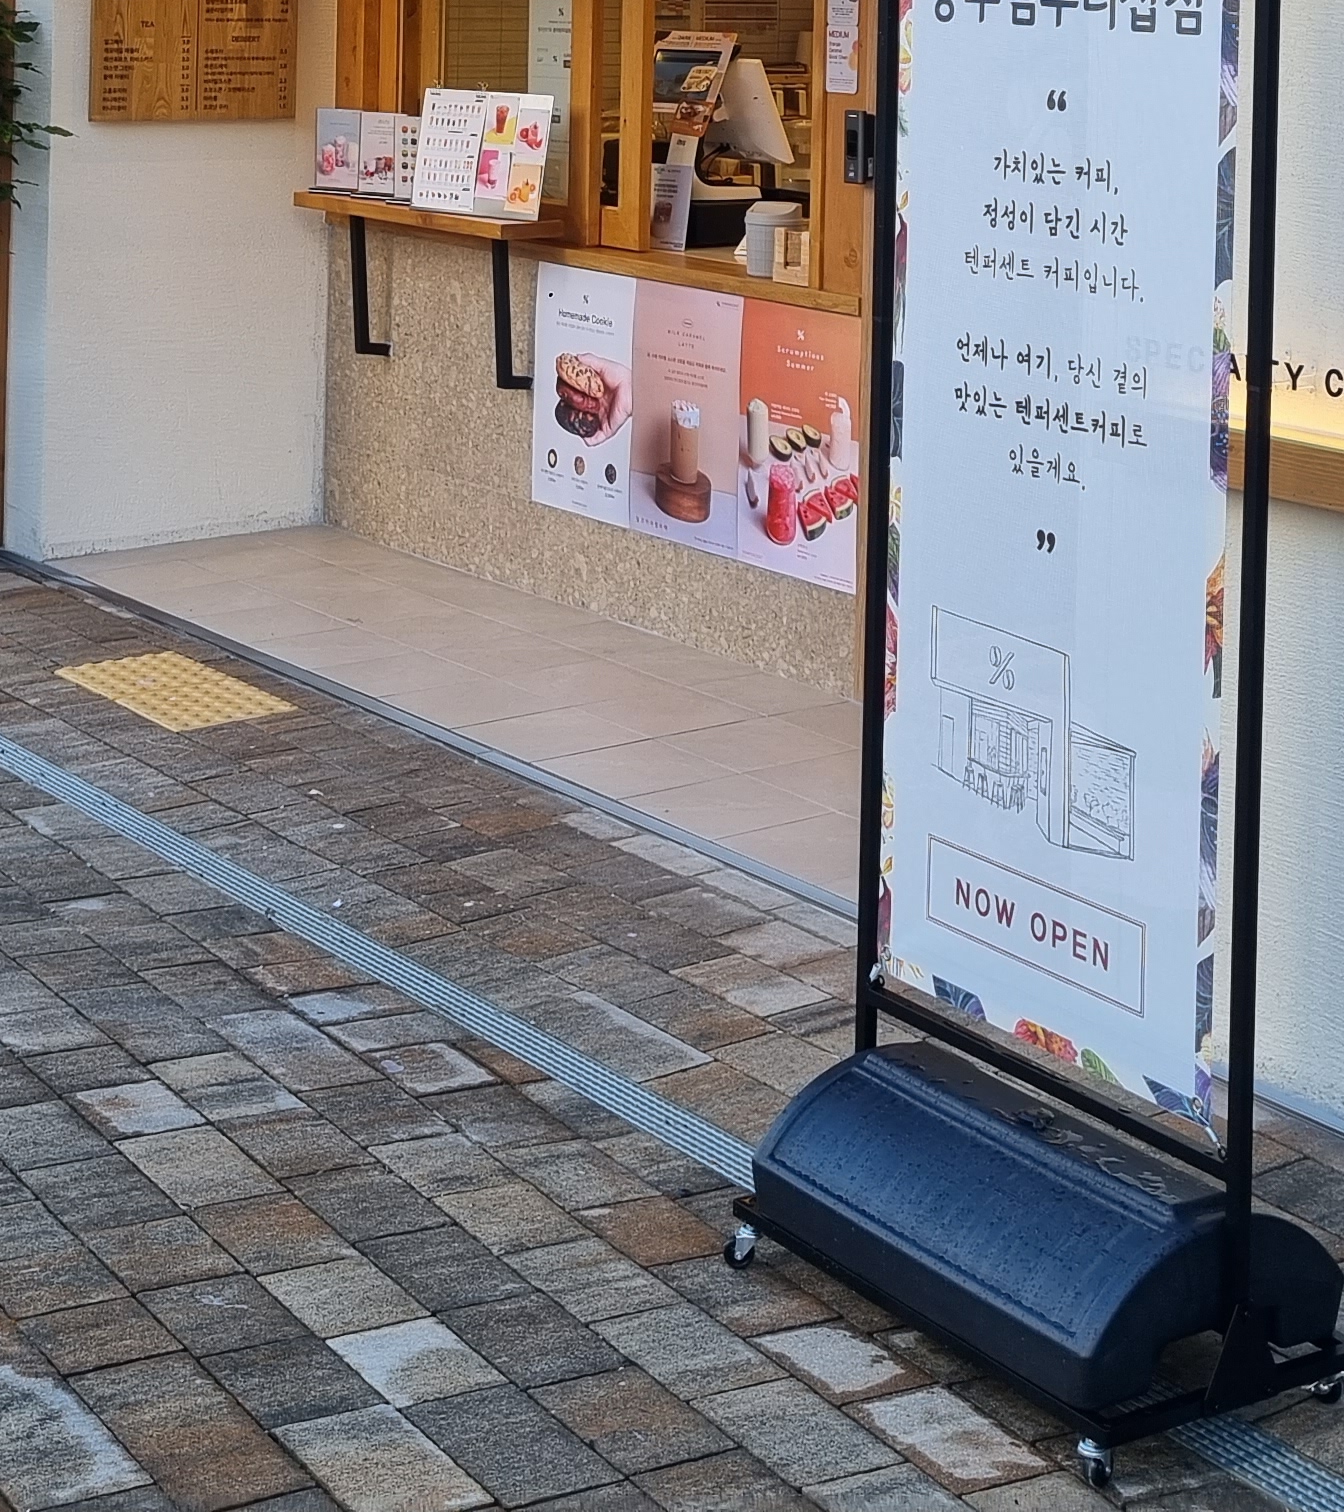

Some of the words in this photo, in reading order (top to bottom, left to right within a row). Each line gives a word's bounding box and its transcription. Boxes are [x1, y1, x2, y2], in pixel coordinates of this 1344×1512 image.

[993, 148, 1067, 186] 가치있는
[1074, 157, 1119, 196] 커피,
[982, 197, 1035, 235] 정성이
[1043, 205, 1082, 240] 담긴
[1089, 211, 1129, 246] 시간
[963, 245, 1035, 281] 텐퍼센트
[1043, 256, 1145, 304] 커피입니다.
[558, 308, 591, 323] Homemade
[591, 314, 613, 328] Cookie
[786, 359, 815, 372] Summer
[956, 331, 1009, 372] 언제나
[1016, 344, 1059, 383] 여기,
[1066, 357, 1103, 389] 당신
[1112, 364, 1148, 400] 곁의
[954, 386, 1009, 418] 맛있는
[1014, 393, 1149, 449] 텐퍼센트커피로
[1008, 443, 1087, 492] 있을게요.
[955, 876, 1016, 929] NOW
[1029, 912, 1110, 972] OPEN
